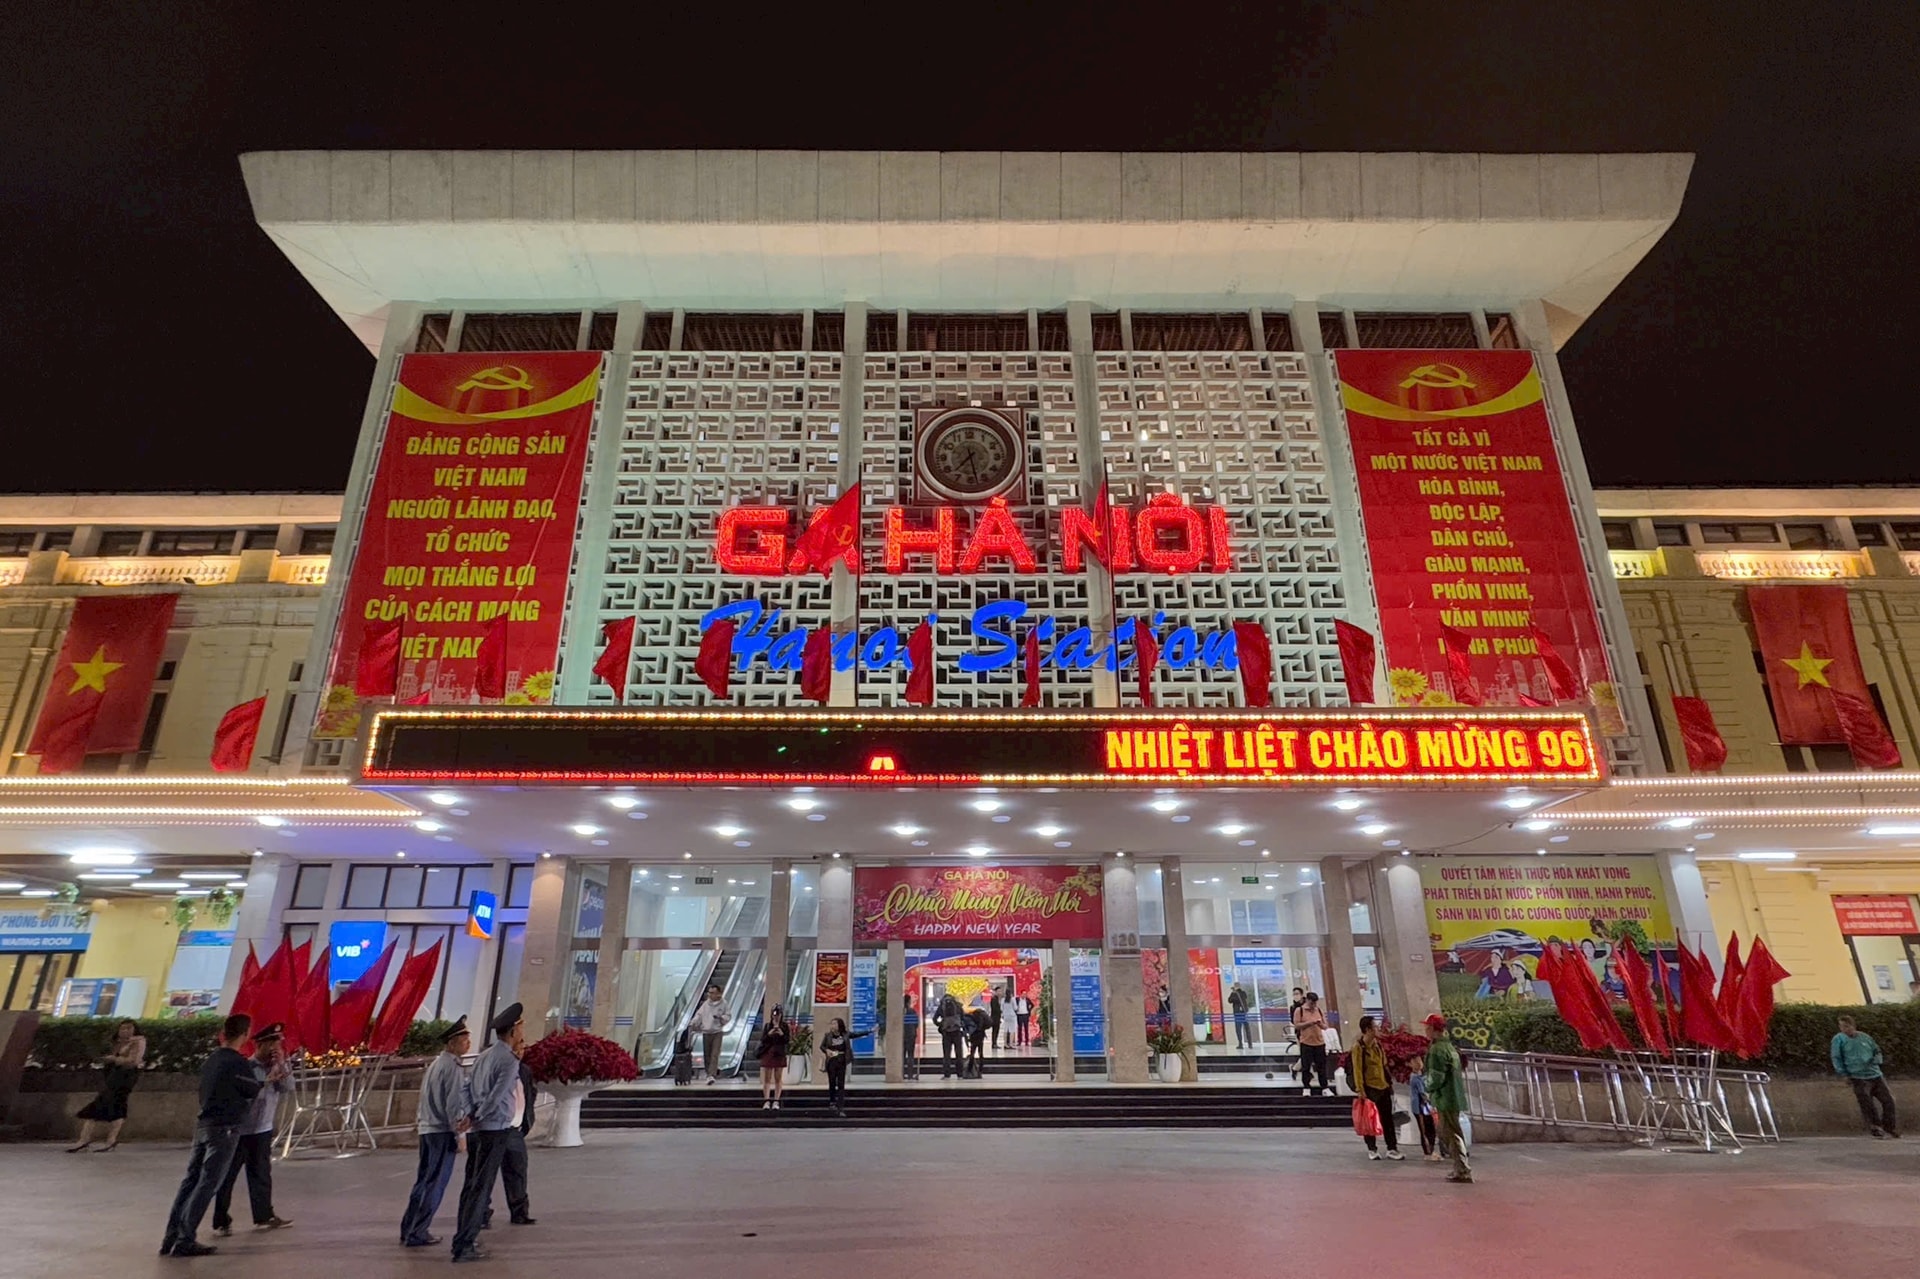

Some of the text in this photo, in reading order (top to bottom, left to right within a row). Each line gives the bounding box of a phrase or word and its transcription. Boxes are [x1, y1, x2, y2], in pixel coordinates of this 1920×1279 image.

[406, 430, 566, 458] ĐẢNG CỘNG SẢN
[964, 431, 974, 439] 12
[1412, 426, 1491, 446] TẤT CẢ VÌ
[1370, 452, 1543, 473] MỘT NƯỚC VIỆT NAM
[434, 464, 528, 491] VIỆT NAM
[1418, 476, 1506, 497] HÒA BÌNH,
[387, 495, 557, 523] NGƯỜI LÃNH ĐẠO,
[1429, 502, 1505, 523] ĐỘC LẬP,
[425, 525, 511, 552] TỔ CHỨC
[887, 495, 1036, 575] HÀ
[1061, 492, 1231, 575] NỘI
[1431, 526, 1514, 549] DÂN CHỦ,
[1425, 553, 1531, 575] GIÀU MẠNH,
[383, 559, 537, 591] MỌI THẮNG LỢI
[1431, 578, 1534, 601] PHỒN VINH,
[364, 594, 408, 621] CỦA
[415, 597, 473, 622] CÁCH
[1440, 607, 1478, 627] VĂN
[1105, 722, 1587, 777] NHIỆT LIỆT CHÀO MỪNG 96
[944, 871, 962, 881] GA
[1441, 864, 1472, 880] QUYẾT
[1473, 865, 1497, 880] TÂM
[1499, 865, 1523, 882] HIỆN
[1524, 866, 1551, 882] THỰC
[1575, 865, 1601, 880] KHÁT
[1604, 867, 1631, 883] VỌNG
[1423, 884, 1449, 900] PHÁT
[1451, 883, 1481, 900] TRIỂN
[1484, 883, 1503, 900] ĐẤT
[1505, 885, 1533, 900] NƯỚC
[1436, 905, 1464, 920] SÁNH
[1466, 907, 1483, 920] VAI
[1484, 905, 1501, 920] VỚI
[1504, 905, 1524, 920] CÁC
[1527, 905, 1562, 920] CƯỜNG
[914, 923, 1042, 936] HAPPY NEW YEAR
[336, 946, 361, 957] VIB
